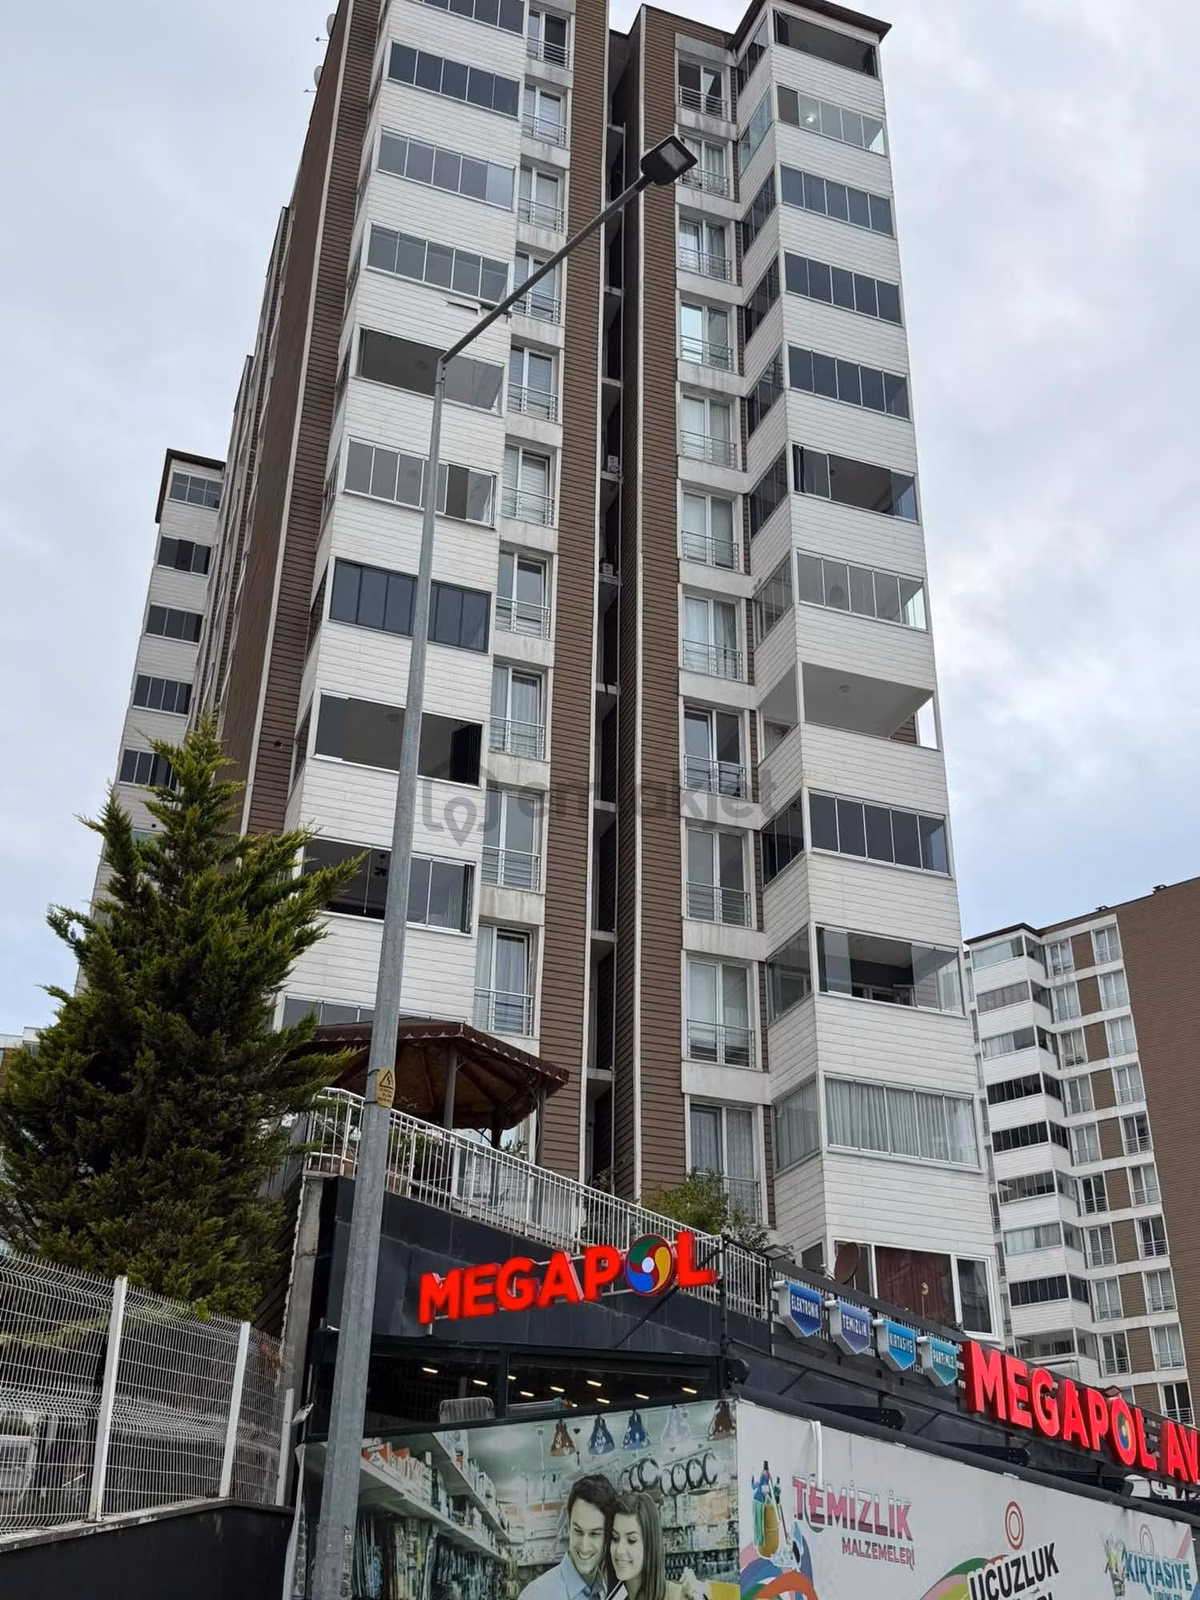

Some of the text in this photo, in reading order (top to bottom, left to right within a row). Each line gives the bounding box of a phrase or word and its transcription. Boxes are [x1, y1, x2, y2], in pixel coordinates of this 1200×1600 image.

[417, 1230, 718, 1325] MEGAPOL
[963, 1340, 1158, 1471] MEGAPOL
[792, 1476, 914, 1541] TEMİZLİK
[969, 1542, 1060, 1600] UCUZLUK
